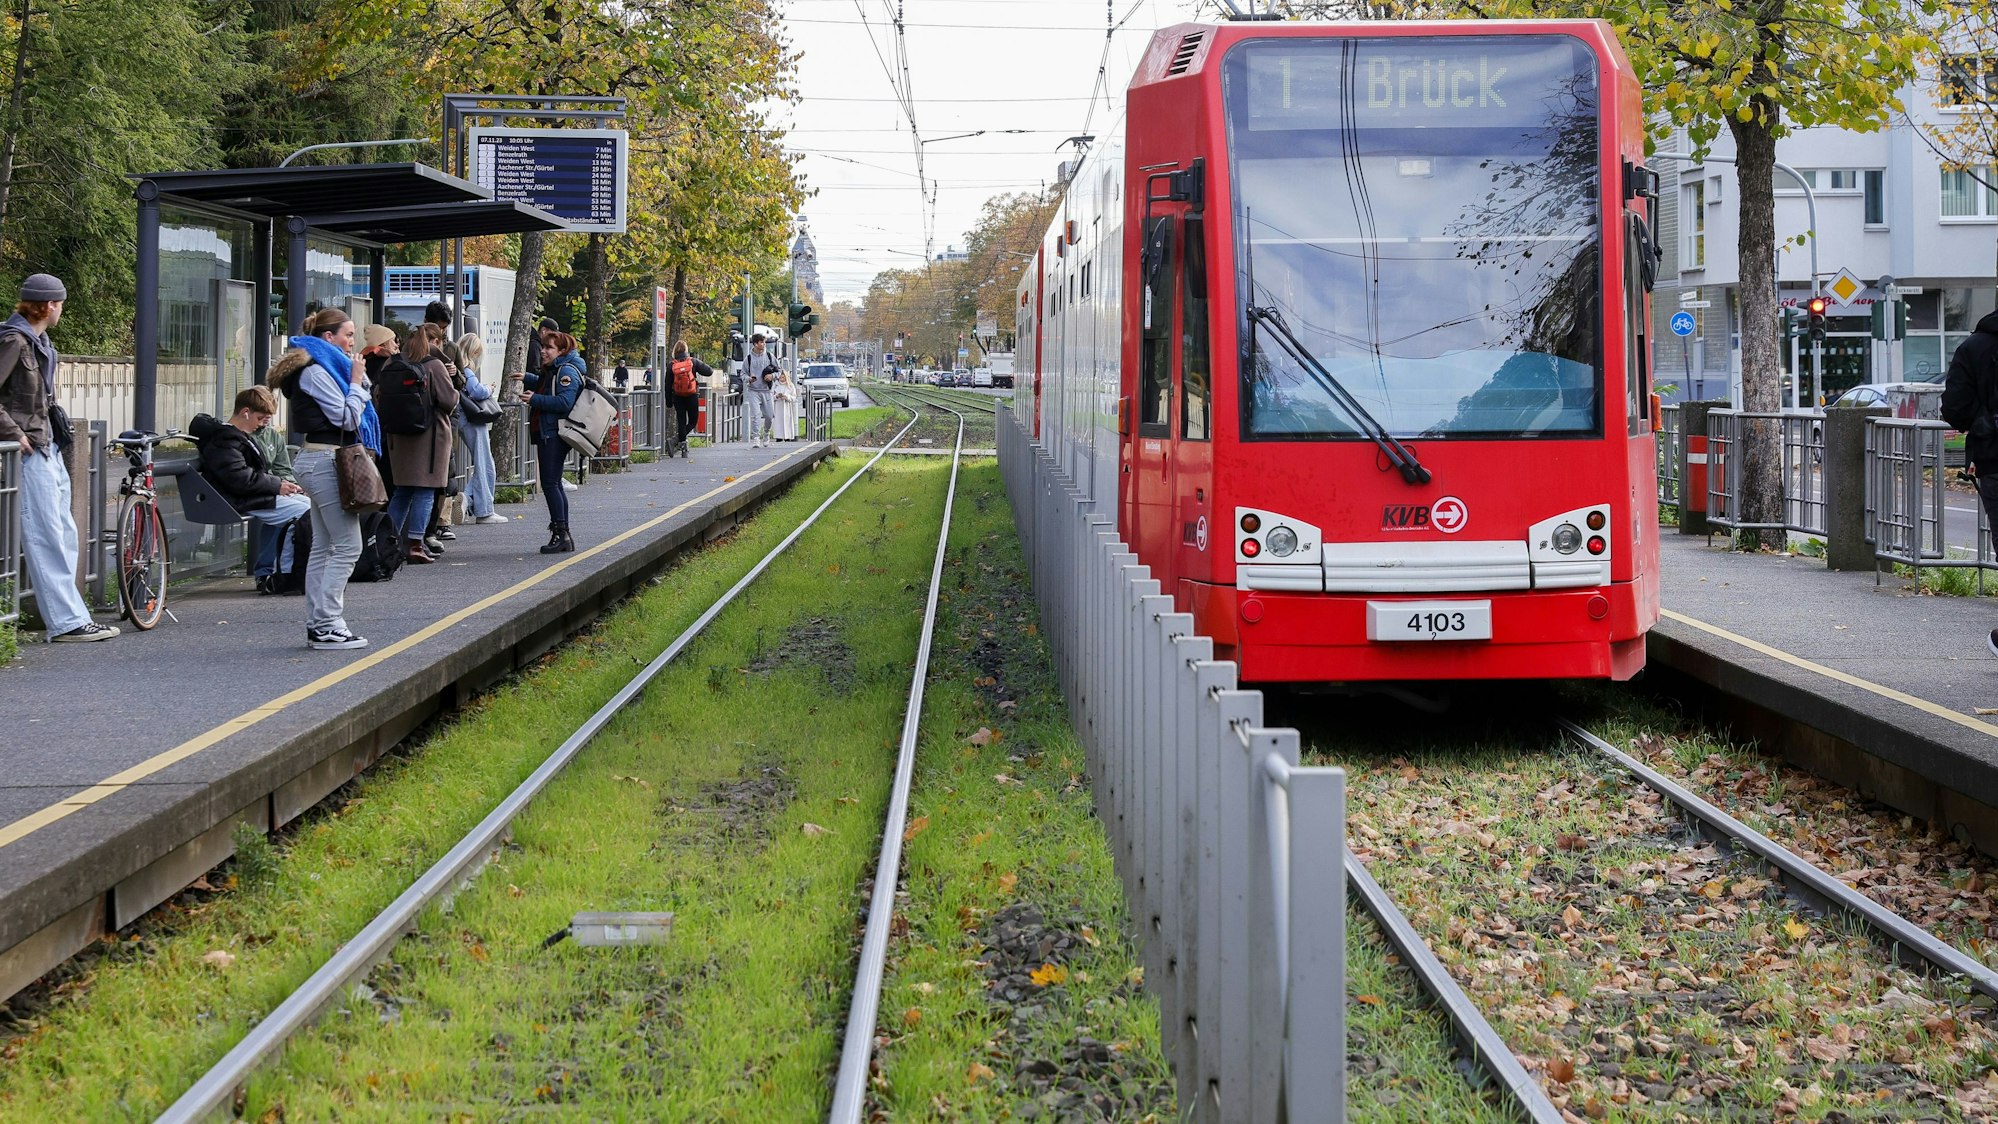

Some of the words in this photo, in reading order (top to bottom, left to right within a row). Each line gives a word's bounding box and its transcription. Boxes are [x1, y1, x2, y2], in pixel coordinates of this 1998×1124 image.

[1279, 56, 1291, 109] 1
[1368, 56, 1508, 108] Brück
[1382, 506, 1430, 526] KVB
[1408, 612, 1465, 632] 4103
